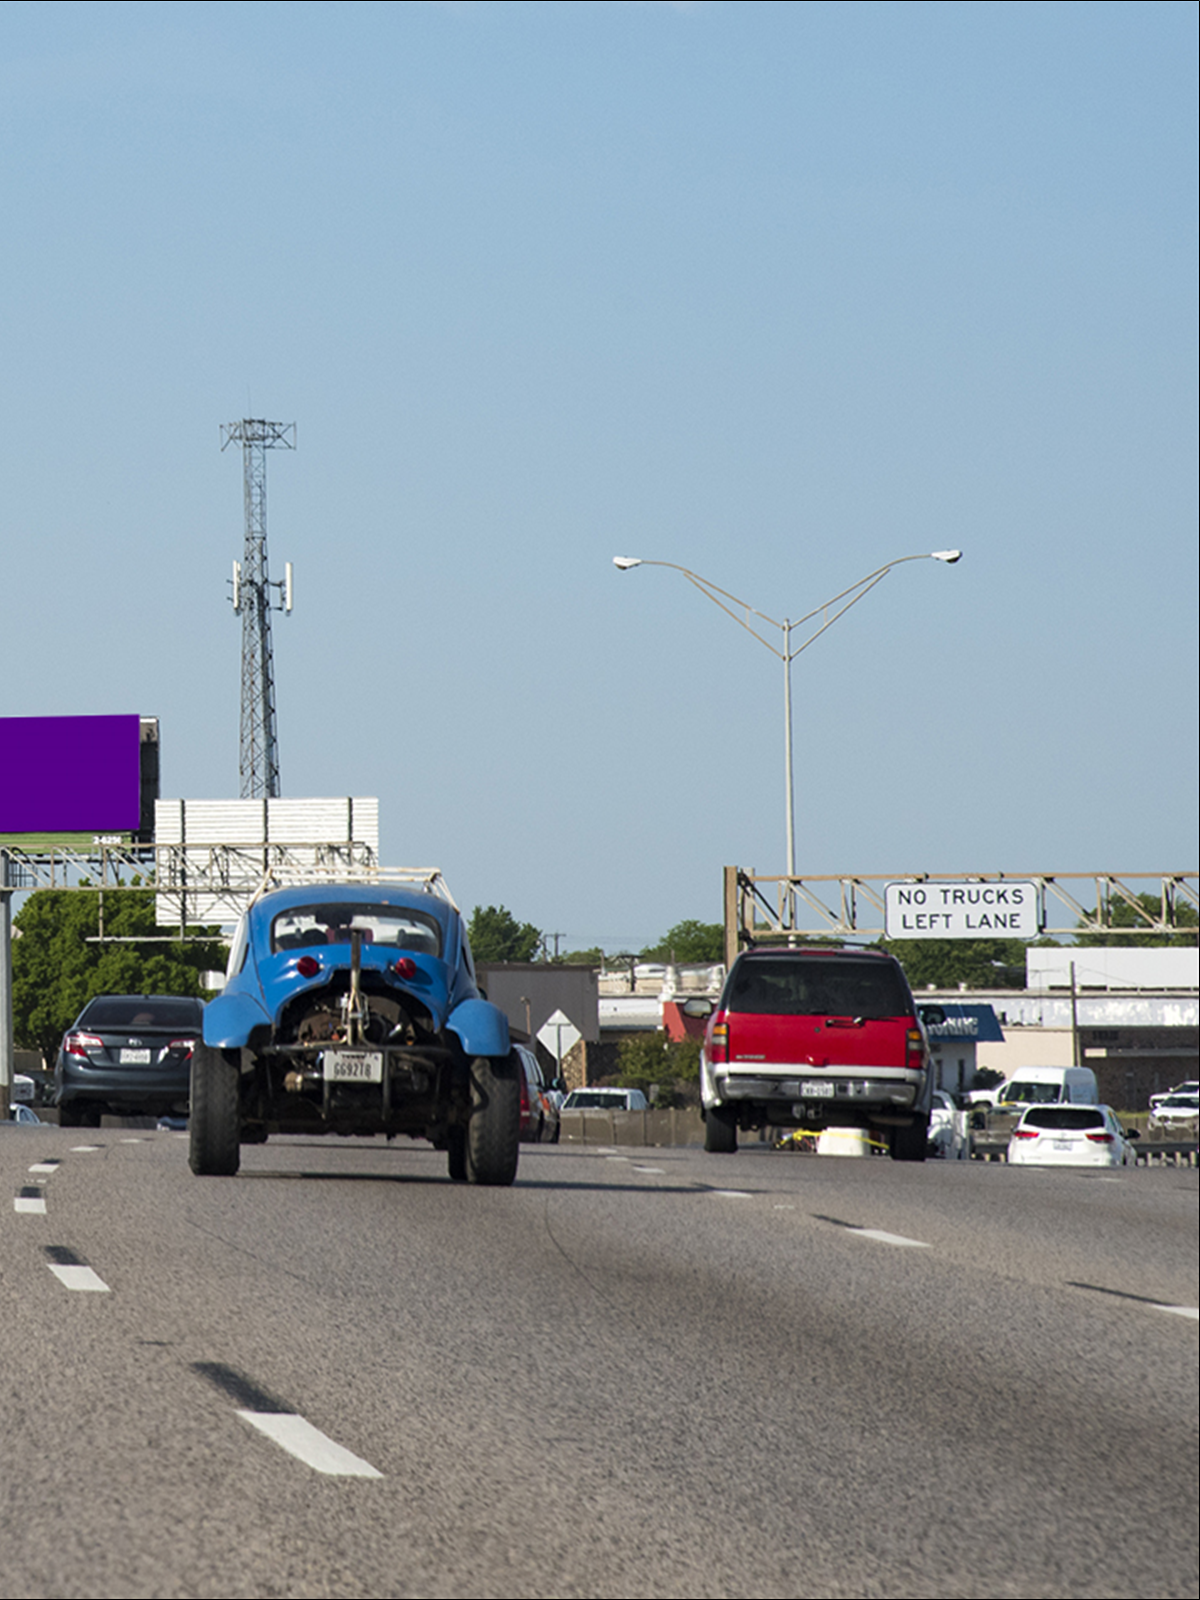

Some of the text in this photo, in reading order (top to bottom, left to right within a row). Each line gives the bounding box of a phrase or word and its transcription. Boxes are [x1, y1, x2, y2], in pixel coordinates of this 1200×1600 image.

[898, 888, 1024, 905] NO TRUCKS
[902, 913, 1021, 929] LEFT LANE
